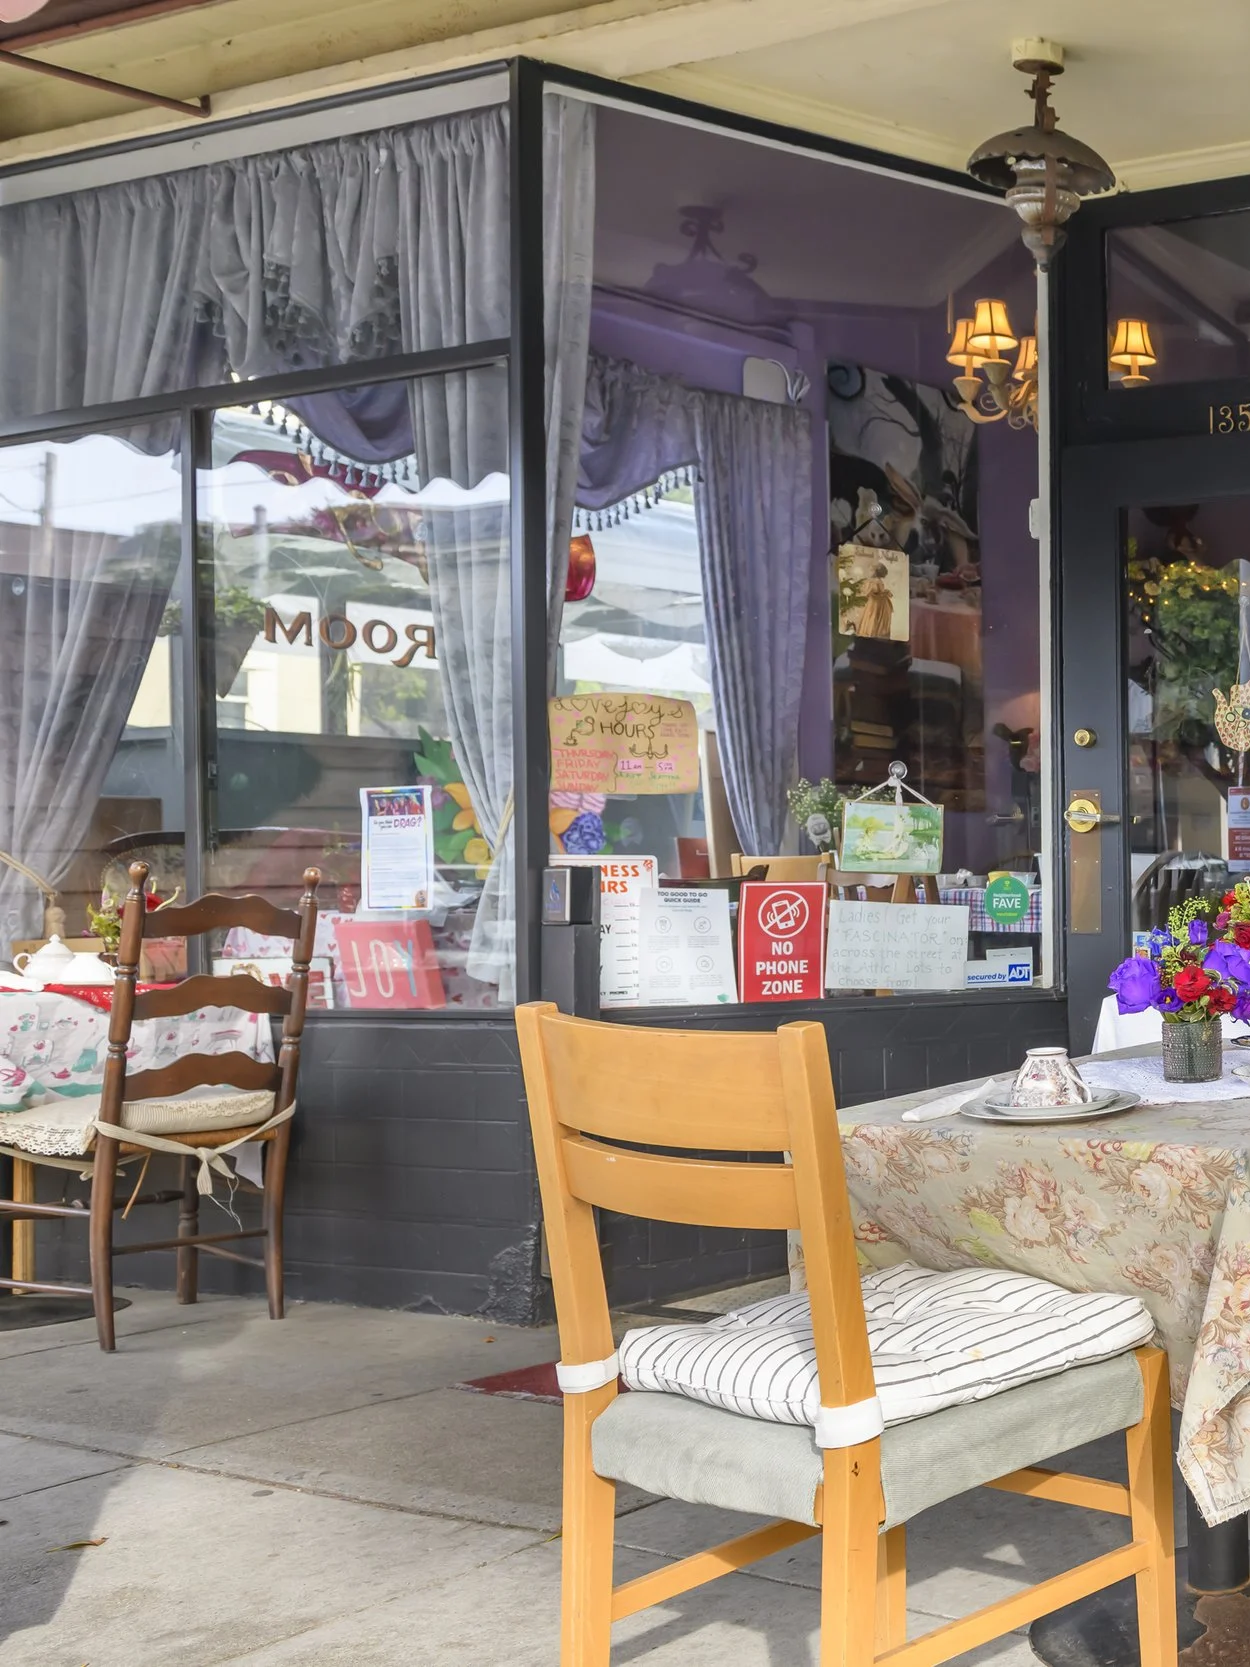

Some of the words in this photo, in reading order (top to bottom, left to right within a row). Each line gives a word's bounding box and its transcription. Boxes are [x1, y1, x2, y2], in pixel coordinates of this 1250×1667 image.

[600, 721, 655, 740] HOURS
[556, 759, 601, 769] FRIDAY
[555, 769, 610, 781] SATURDAY
[556, 781, 600, 792] SUNDAY
[993, 897, 1021, 909] FAVE
[896, 906, 918, 925] Get
[924, 916, 951, 932] your
[771, 940, 794, 956] NO
[832, 948, 876, 958] across
[880, 947, 901, 958] the
[906, 948, 942, 959] street
[350, 939, 416, 999] JOY
[755, 960, 809, 976] PHONE
[906, 962, 933, 974] Lots
[938, 962, 953, 974] to
[997, 973, 1007, 981] by
[1008, 965, 1031, 980] ADT
[761, 979, 804, 995] ZONE
